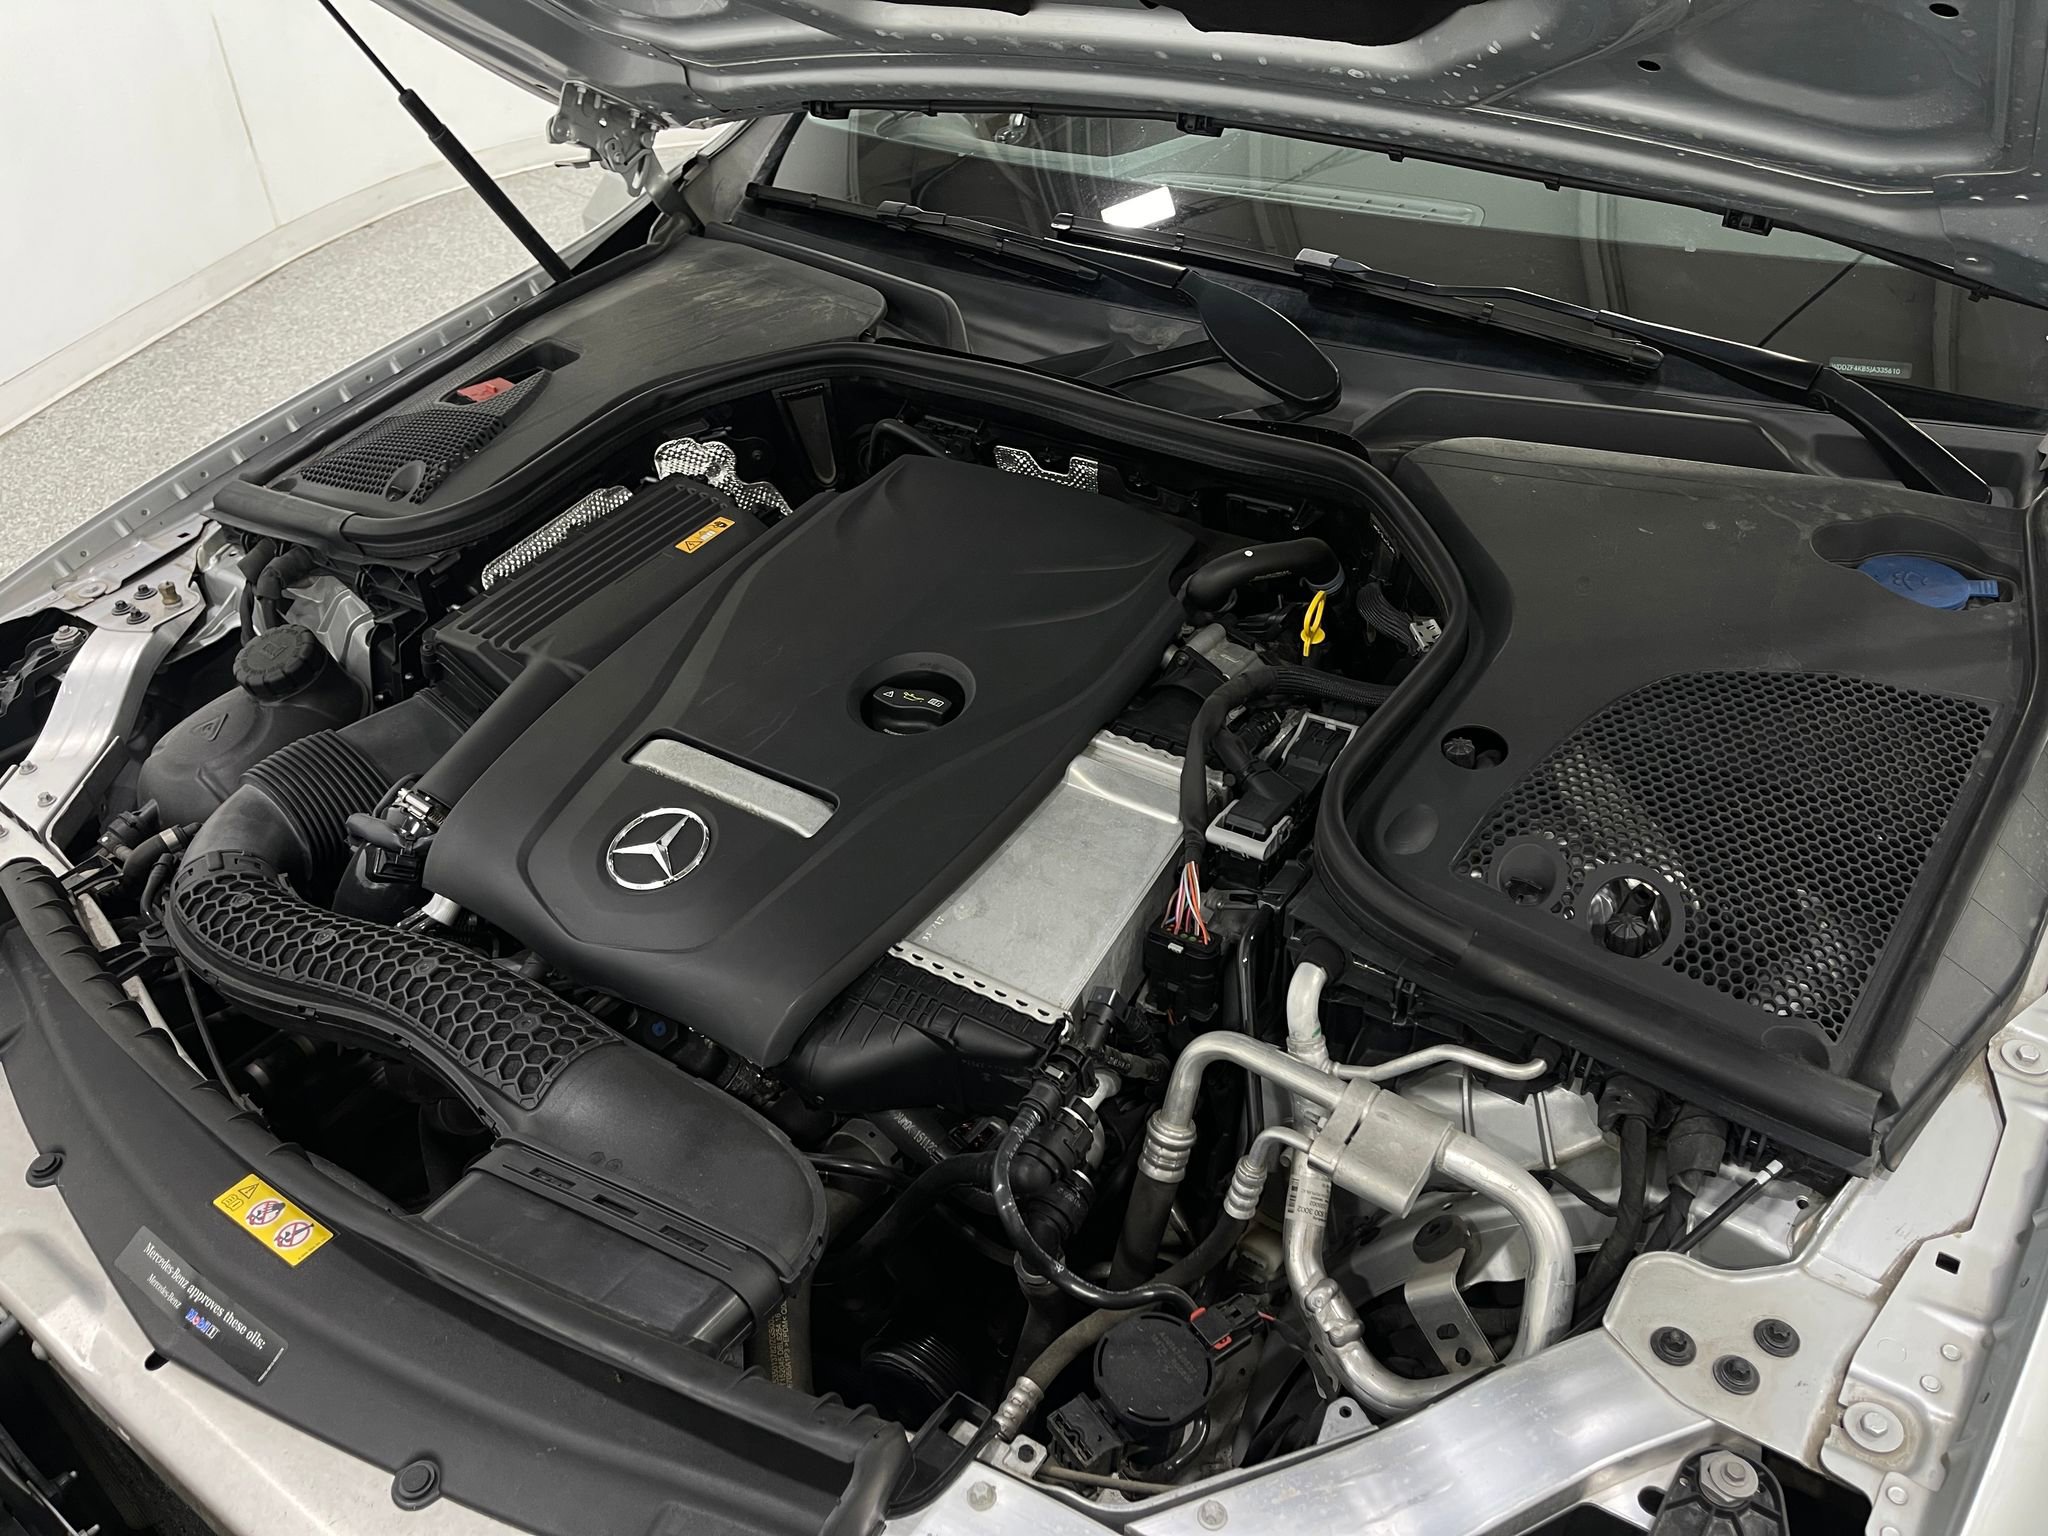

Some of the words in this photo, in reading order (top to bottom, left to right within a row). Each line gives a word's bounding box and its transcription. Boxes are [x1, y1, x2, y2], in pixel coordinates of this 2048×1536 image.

[143, 1241, 190, 1290] Mercedes-Benz
[186, 1284, 225, 1318] approves
[223, 1309, 248, 1335] these
[245, 1329, 266, 1351] oils:
[146, 1273, 183, 1310] Mercedes-Benz
[184, 1306, 210, 1334] Mobil
